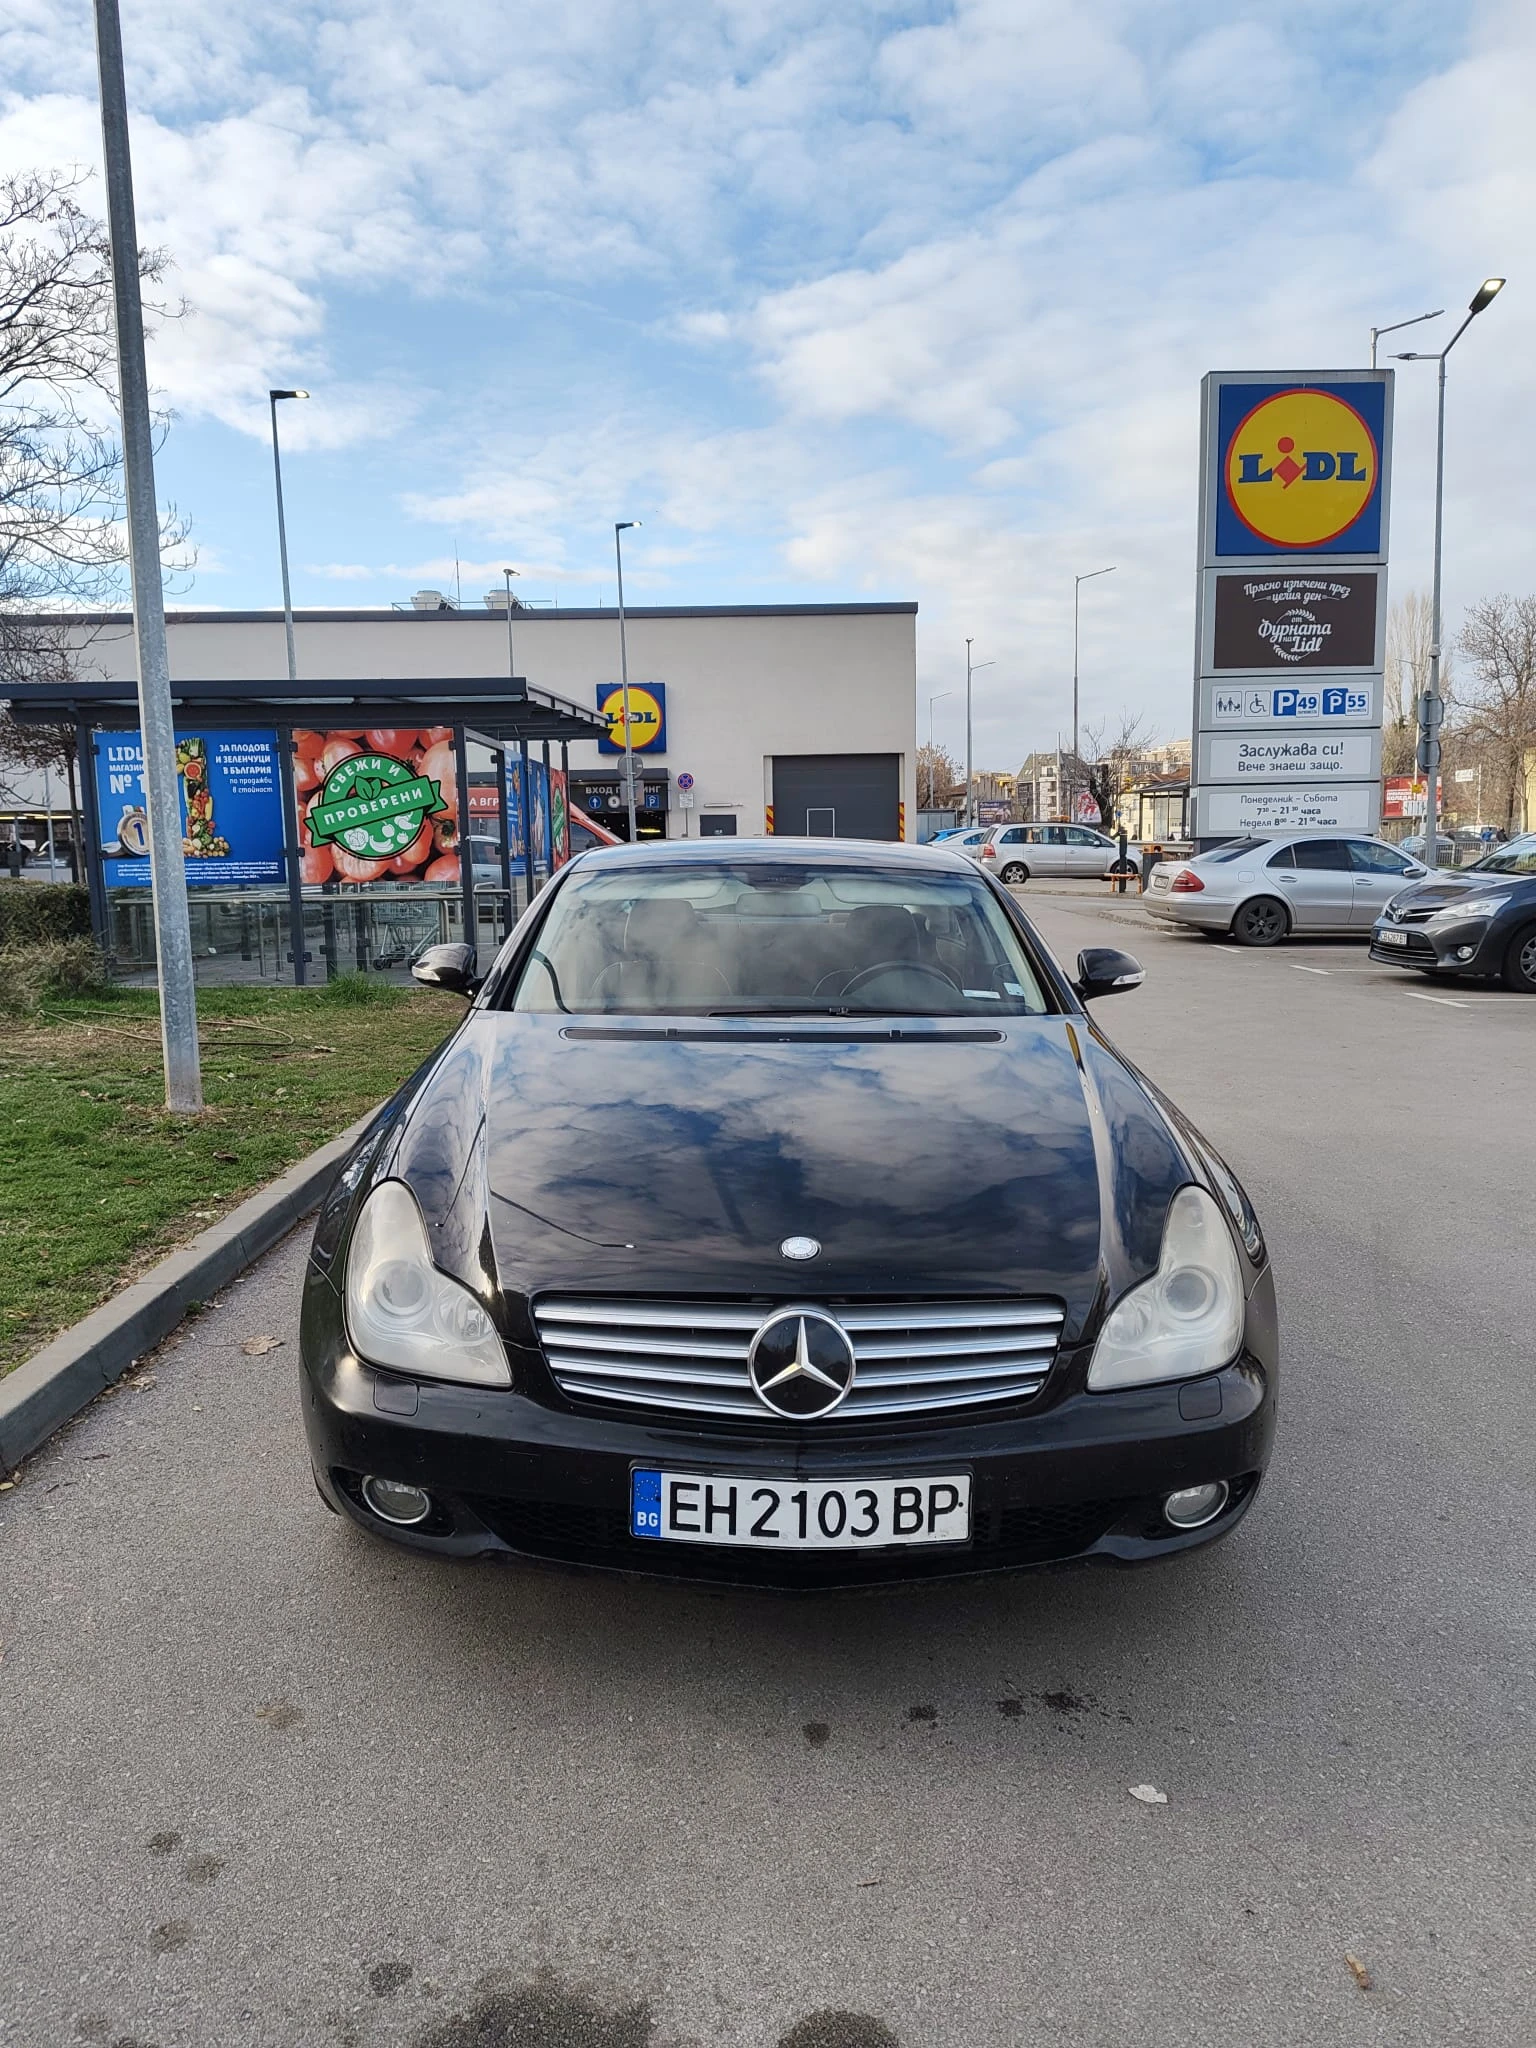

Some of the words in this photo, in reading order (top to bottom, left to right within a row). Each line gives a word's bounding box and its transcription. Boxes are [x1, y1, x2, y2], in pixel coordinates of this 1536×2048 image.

[1238, 437, 1366, 489] LIDL
[1244, 582, 1281, 598] Прясно
[1283, 580, 1327, 592] изпечени
[1328, 583, 1351, 598] през
[1272, 593, 1301, 603] целия
[1303, 593, 1322, 604] ден
[1258, 619, 1332, 643] Фурната
[1291, 636, 1323, 652] Lidl
[1297, 696, 1318, 710] 49
[1347, 694, 1366, 708] 55
[219, 744, 230, 752] ЗА
[231, 744, 270, 753] ПЛОДОВЕ
[1239, 743, 1317, 760] Заслужава
[1322, 742, 1344, 756] си!
[215, 755, 222, 764] И
[223, 755, 271, 764] ЗЕЛЕНЧУЦИ
[1238, 761, 1266, 772] Вече
[1269, 761, 1306, 772] знаеш
[1309, 760, 1343, 772] защо.
[223, 766, 229, 775] В
[230, 766, 272, 775] БЪЛГАРИЯ
[329, 758, 381, 794] СВЕЖИ
[388, 764, 401, 777] И
[240, 776, 273, 786] продажби
[585, 786, 613, 795] ВХОД
[323, 787, 424, 826] ПРОВЕРЕНИ
[1240, 794, 1293, 805] Понеделник
[1303, 794, 1338, 803] Събота
[1240, 818, 1272, 829] Неделя
[637, 1512, 658, 1527] BG
